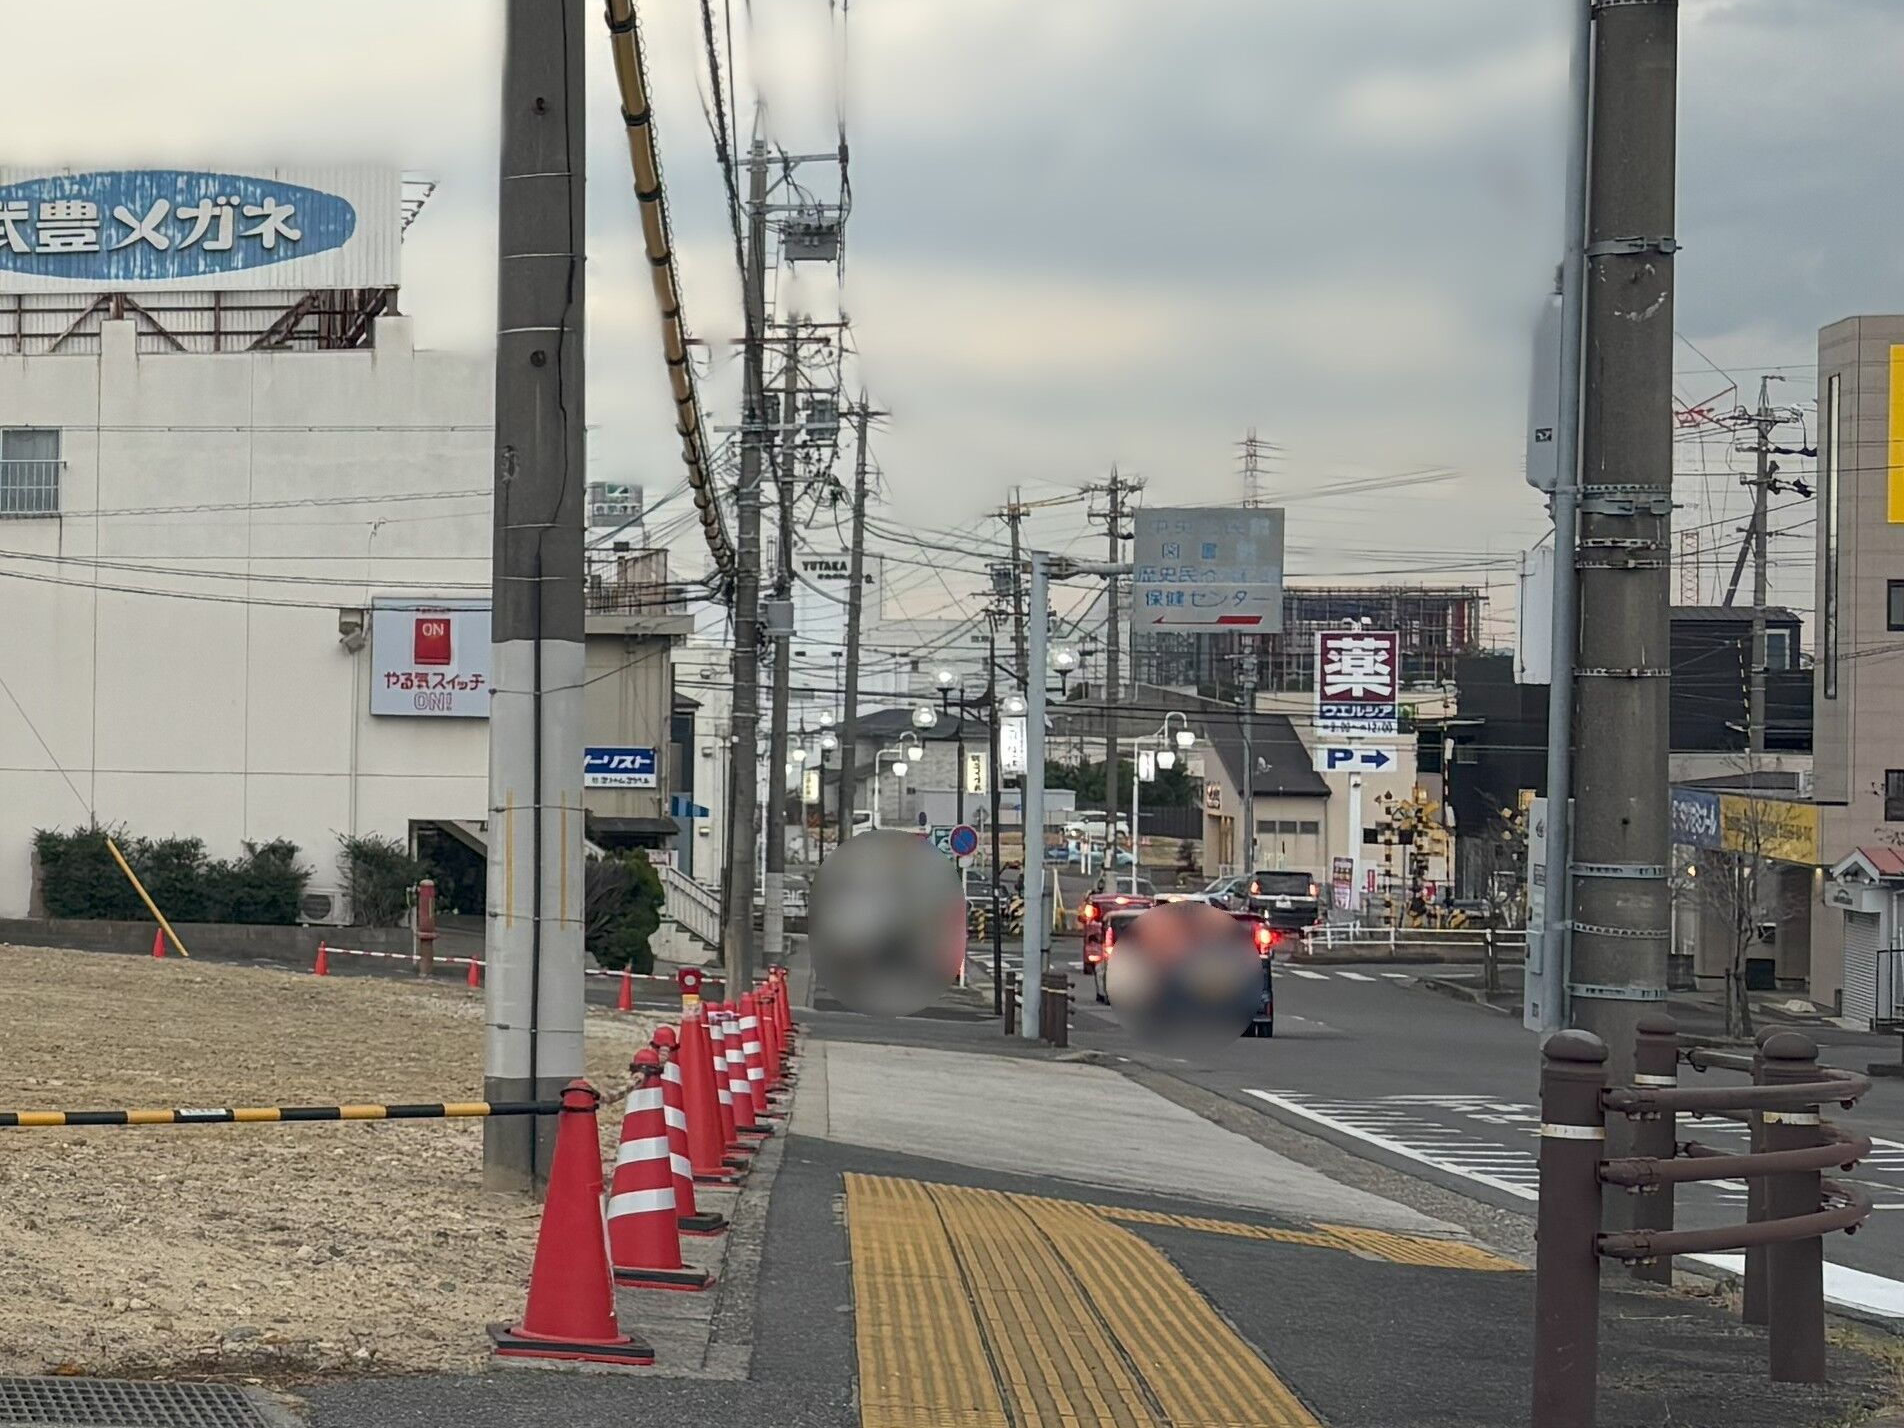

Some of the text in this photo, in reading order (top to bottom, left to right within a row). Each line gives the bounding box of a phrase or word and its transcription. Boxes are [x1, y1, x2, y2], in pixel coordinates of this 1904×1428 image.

[802, 561, 848, 571] YUTAKA
[1145, 590, 1272, 606] 保健センター
[422, 623, 444, 636] ON
[1323, 637, 1392, 697] 薬
[384, 672, 485, 690] やる気スイッチ
[414, 692, 453, 711] ON!
[1322, 705, 1393, 717] ウエルシア
[1327, 748, 1354, 769] P
